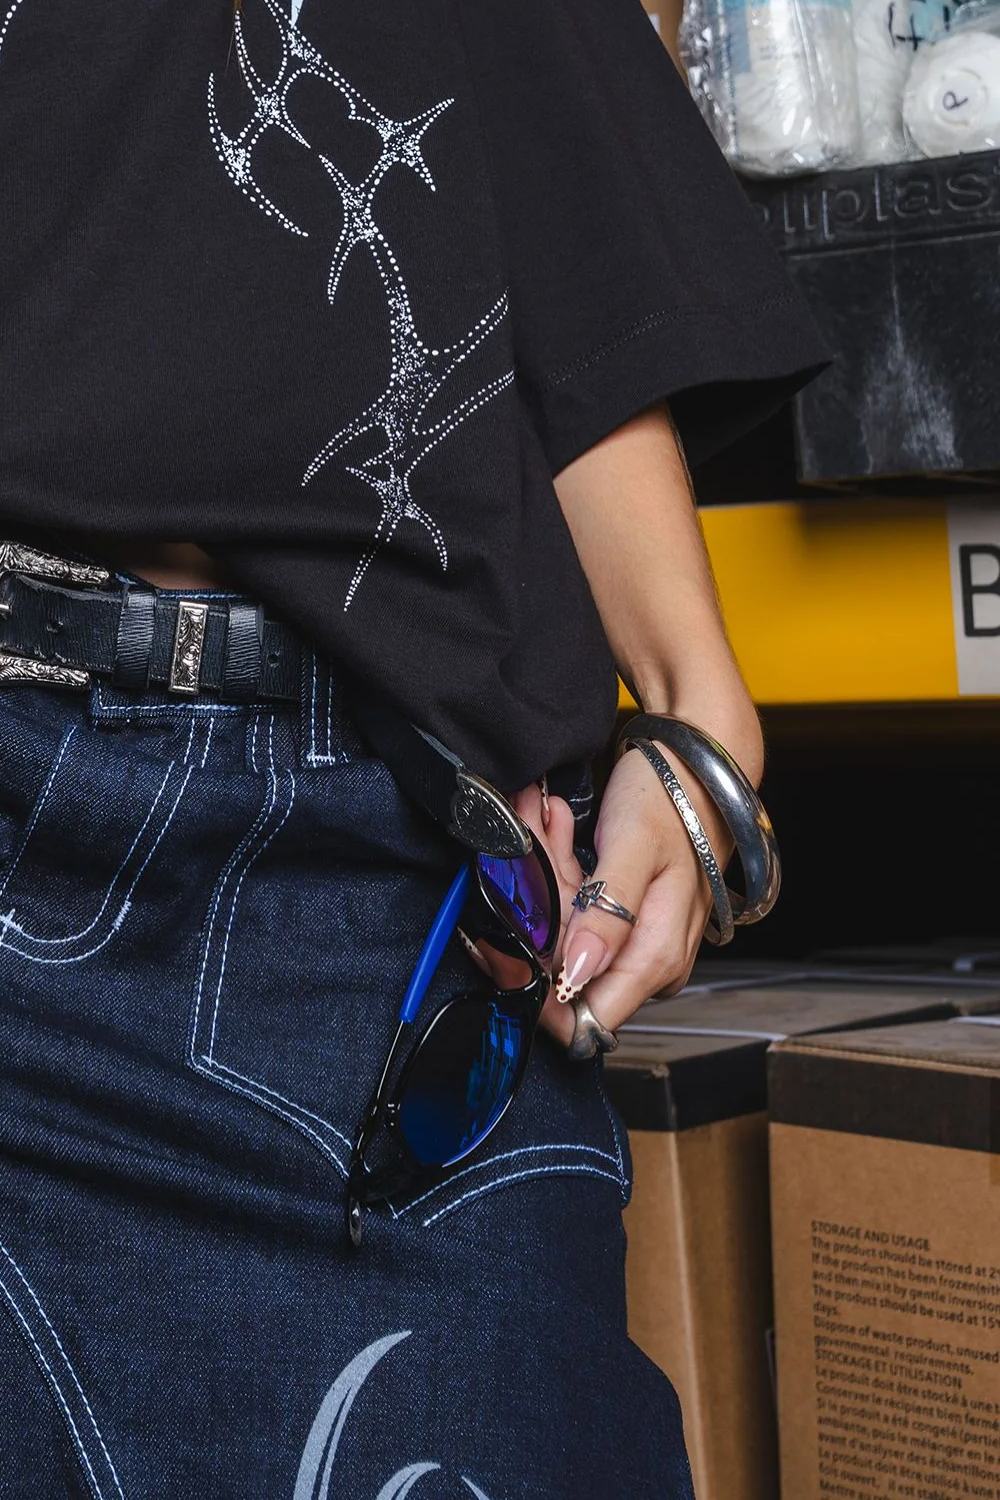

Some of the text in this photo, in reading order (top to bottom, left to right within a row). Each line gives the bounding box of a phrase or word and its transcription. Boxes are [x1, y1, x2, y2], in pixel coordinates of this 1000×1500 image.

[811, 1220, 930, 1251] STORAGE AND USAGE
[812, 1235, 830, 1250] The
[833, 1242, 876, 1258] product
[878, 1247, 916, 1265] should
[919, 1254, 932, 1268] be
[936, 1260, 972, 1275] stored
[975, 1267, 986, 1276] at
[822, 1255, 839, 1267] the
[841, 1260, 884, 1275] product
[887, 1266, 905, 1280] has
[908, 1268, 937, 1285] been
[812, 1269, 832, 1282] and
[835, 1272, 859, 1286] then
[894, 1283, 907, 1298] by
[909, 1289, 945, 1303] gentle
[812, 1283, 832, 1297] The
[835, 1291, 877, 1306] product
[880, 1296, 917, 1315] should
[920, 1303, 934, 1318] be
[936, 1311, 963, 1323] used
[966, 1315, 978, 1326] at
[814, 1315, 855, 1334] Dispose
[859, 1325, 870, 1338] of
[872, 1331, 904, 1345] waste
[957, 1348, 999, 1363] unused
[814, 1335, 889, 1357] governmental
[815, 1348, 962, 1390] STOCKAGE ET UTILISATION
[816, 1365, 826, 1377] Le
[830, 1369, 869, 1386] produit
[872, 1377, 894, 1391] doit
[970, 1400, 993, 1413] une
[816, 1380, 869, 1402] Conserver
[872, 1393, 881, 1405] le
[936, 1406, 962, 1424] bien
[840, 1405, 880, 1421] produit
[818, 1432, 846, 1447] avant
[907, 1451, 926, 1465] des
[872, 1428, 895, 1442] puis
[898, 1432, 907, 1444] le
[967, 1451, 981, 1460] en
[984, 1450, 995, 1464] le
[832, 1452, 873, 1469] produit
[875, 1461, 897, 1476] doit
